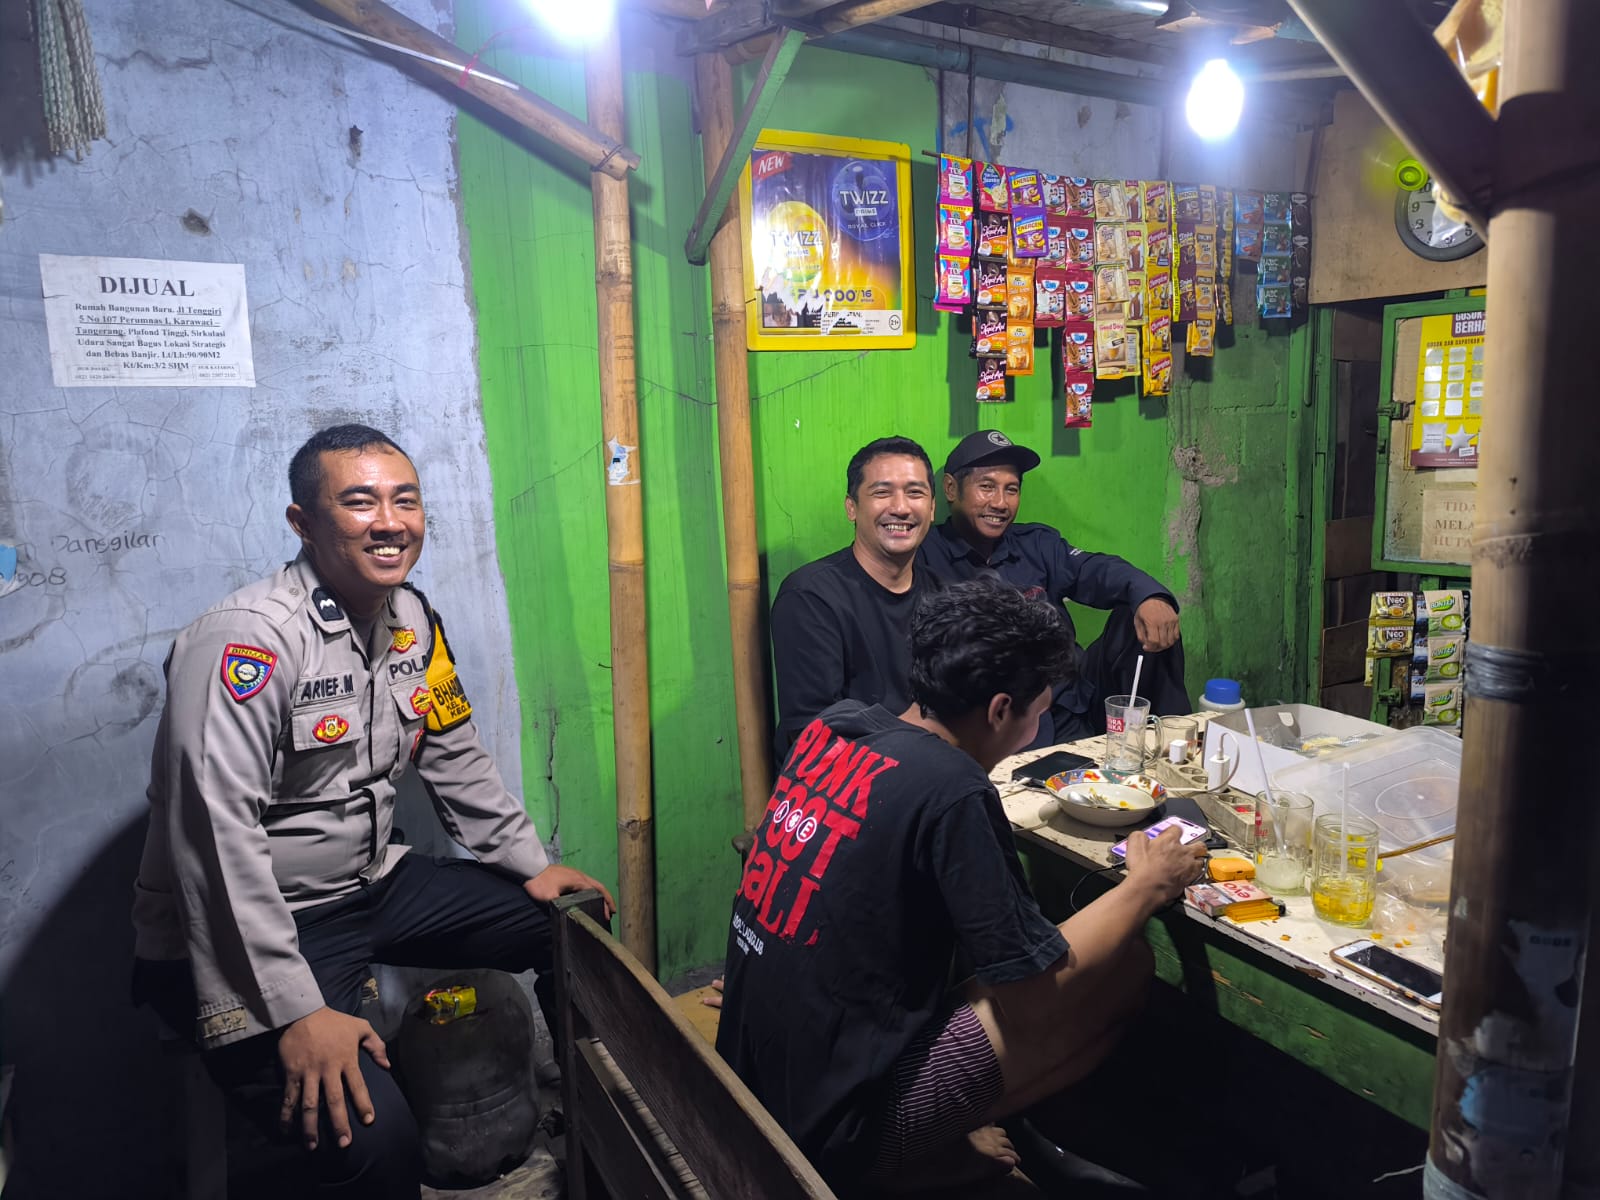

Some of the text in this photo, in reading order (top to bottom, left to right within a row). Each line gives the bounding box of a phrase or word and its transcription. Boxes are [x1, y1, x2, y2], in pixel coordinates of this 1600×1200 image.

[758, 155, 785, 175] NEW
[839, 190, 889, 206] TWIZZ
[1411, 201, 1421, 213] 9
[100, 275, 195, 298] DIJUAL
[75, 303, 106, 311] Rumah
[108, 304, 150, 313] Bangunan
[102, 315, 117, 323] 107
[120, 316, 162, 324] Perumnas
[173, 317, 213, 326] Karawaci
[128, 328, 159, 336] Plafond
[77, 338, 227, 349] Udara Sangat Bagus Lokasi Strategis
[104, 350, 129, 358] Bebas
[168, 362, 189, 370] SHM
[231, 648, 271, 662] BINMAS
[784, 718, 900, 820] PUNK
[755, 775, 861, 879] FOOT
